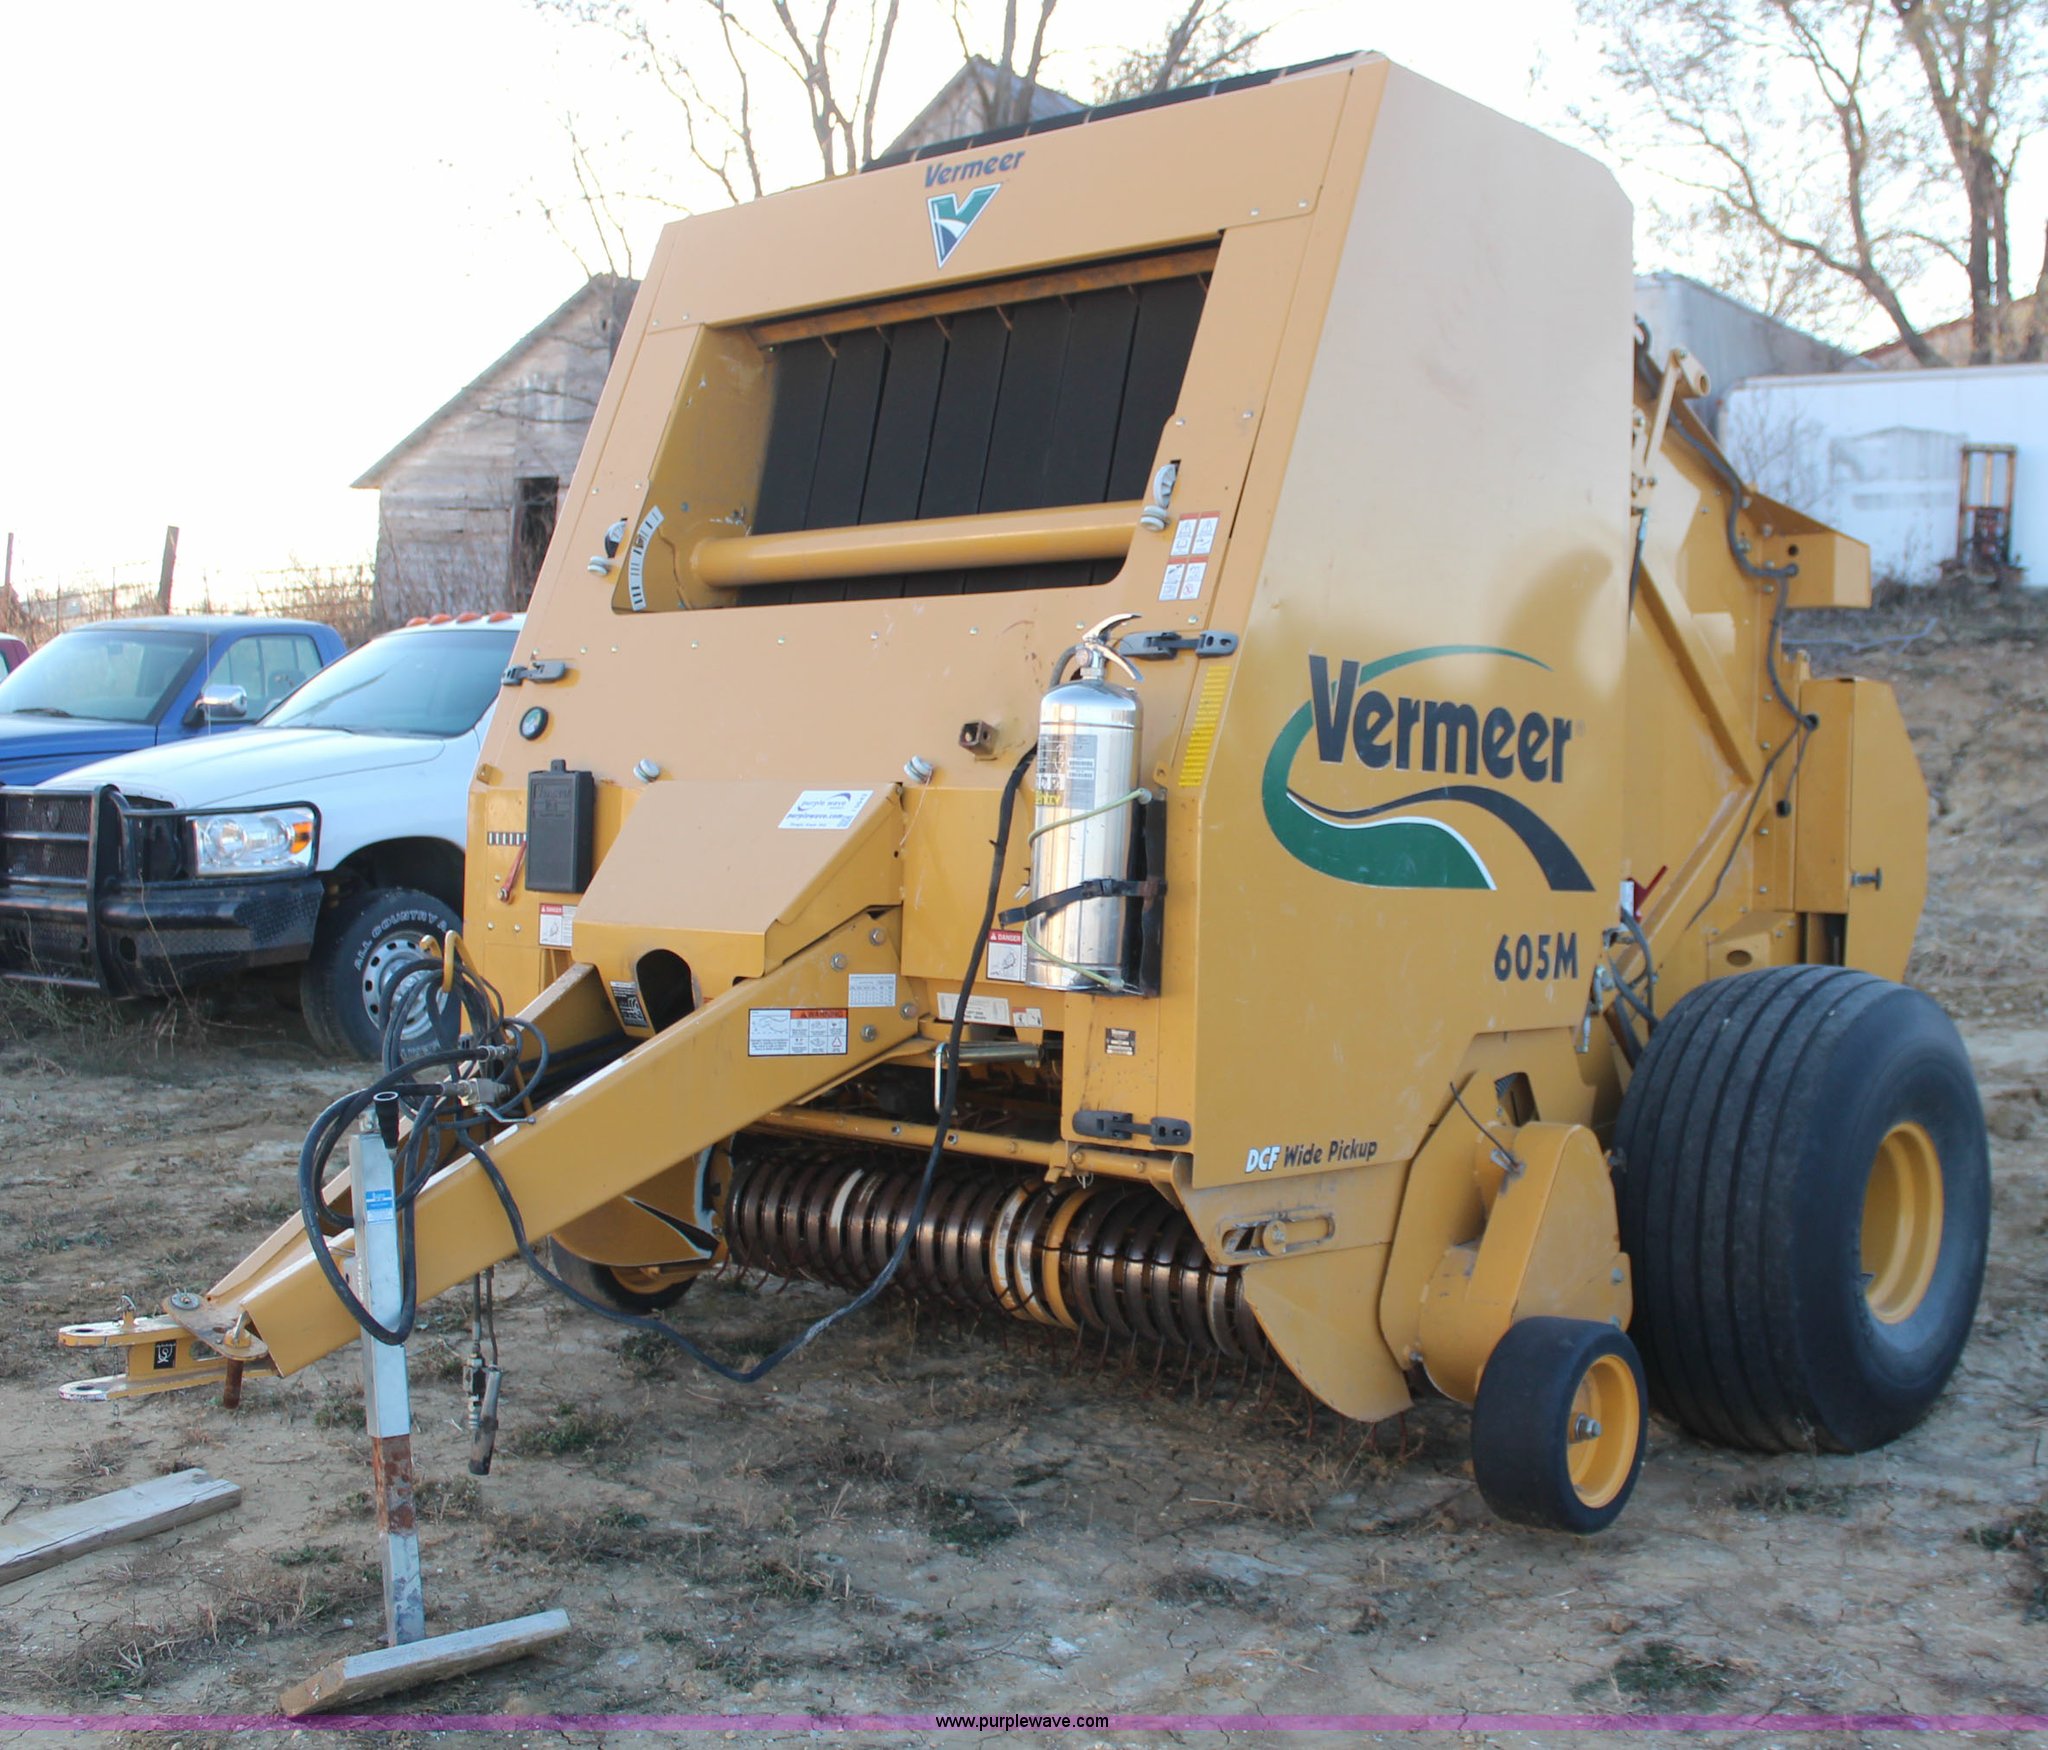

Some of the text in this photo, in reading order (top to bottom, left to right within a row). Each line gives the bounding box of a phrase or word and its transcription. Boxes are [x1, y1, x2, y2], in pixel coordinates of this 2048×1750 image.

[925, 150, 1025, 188] Vermeer
[1308, 654, 1572, 783] Vermeer
[997, 932, 1020, 941] DANGER
[1494, 931, 1579, 981] 605M
[1245, 1138, 1378, 1174] DCF Wide Pickup
